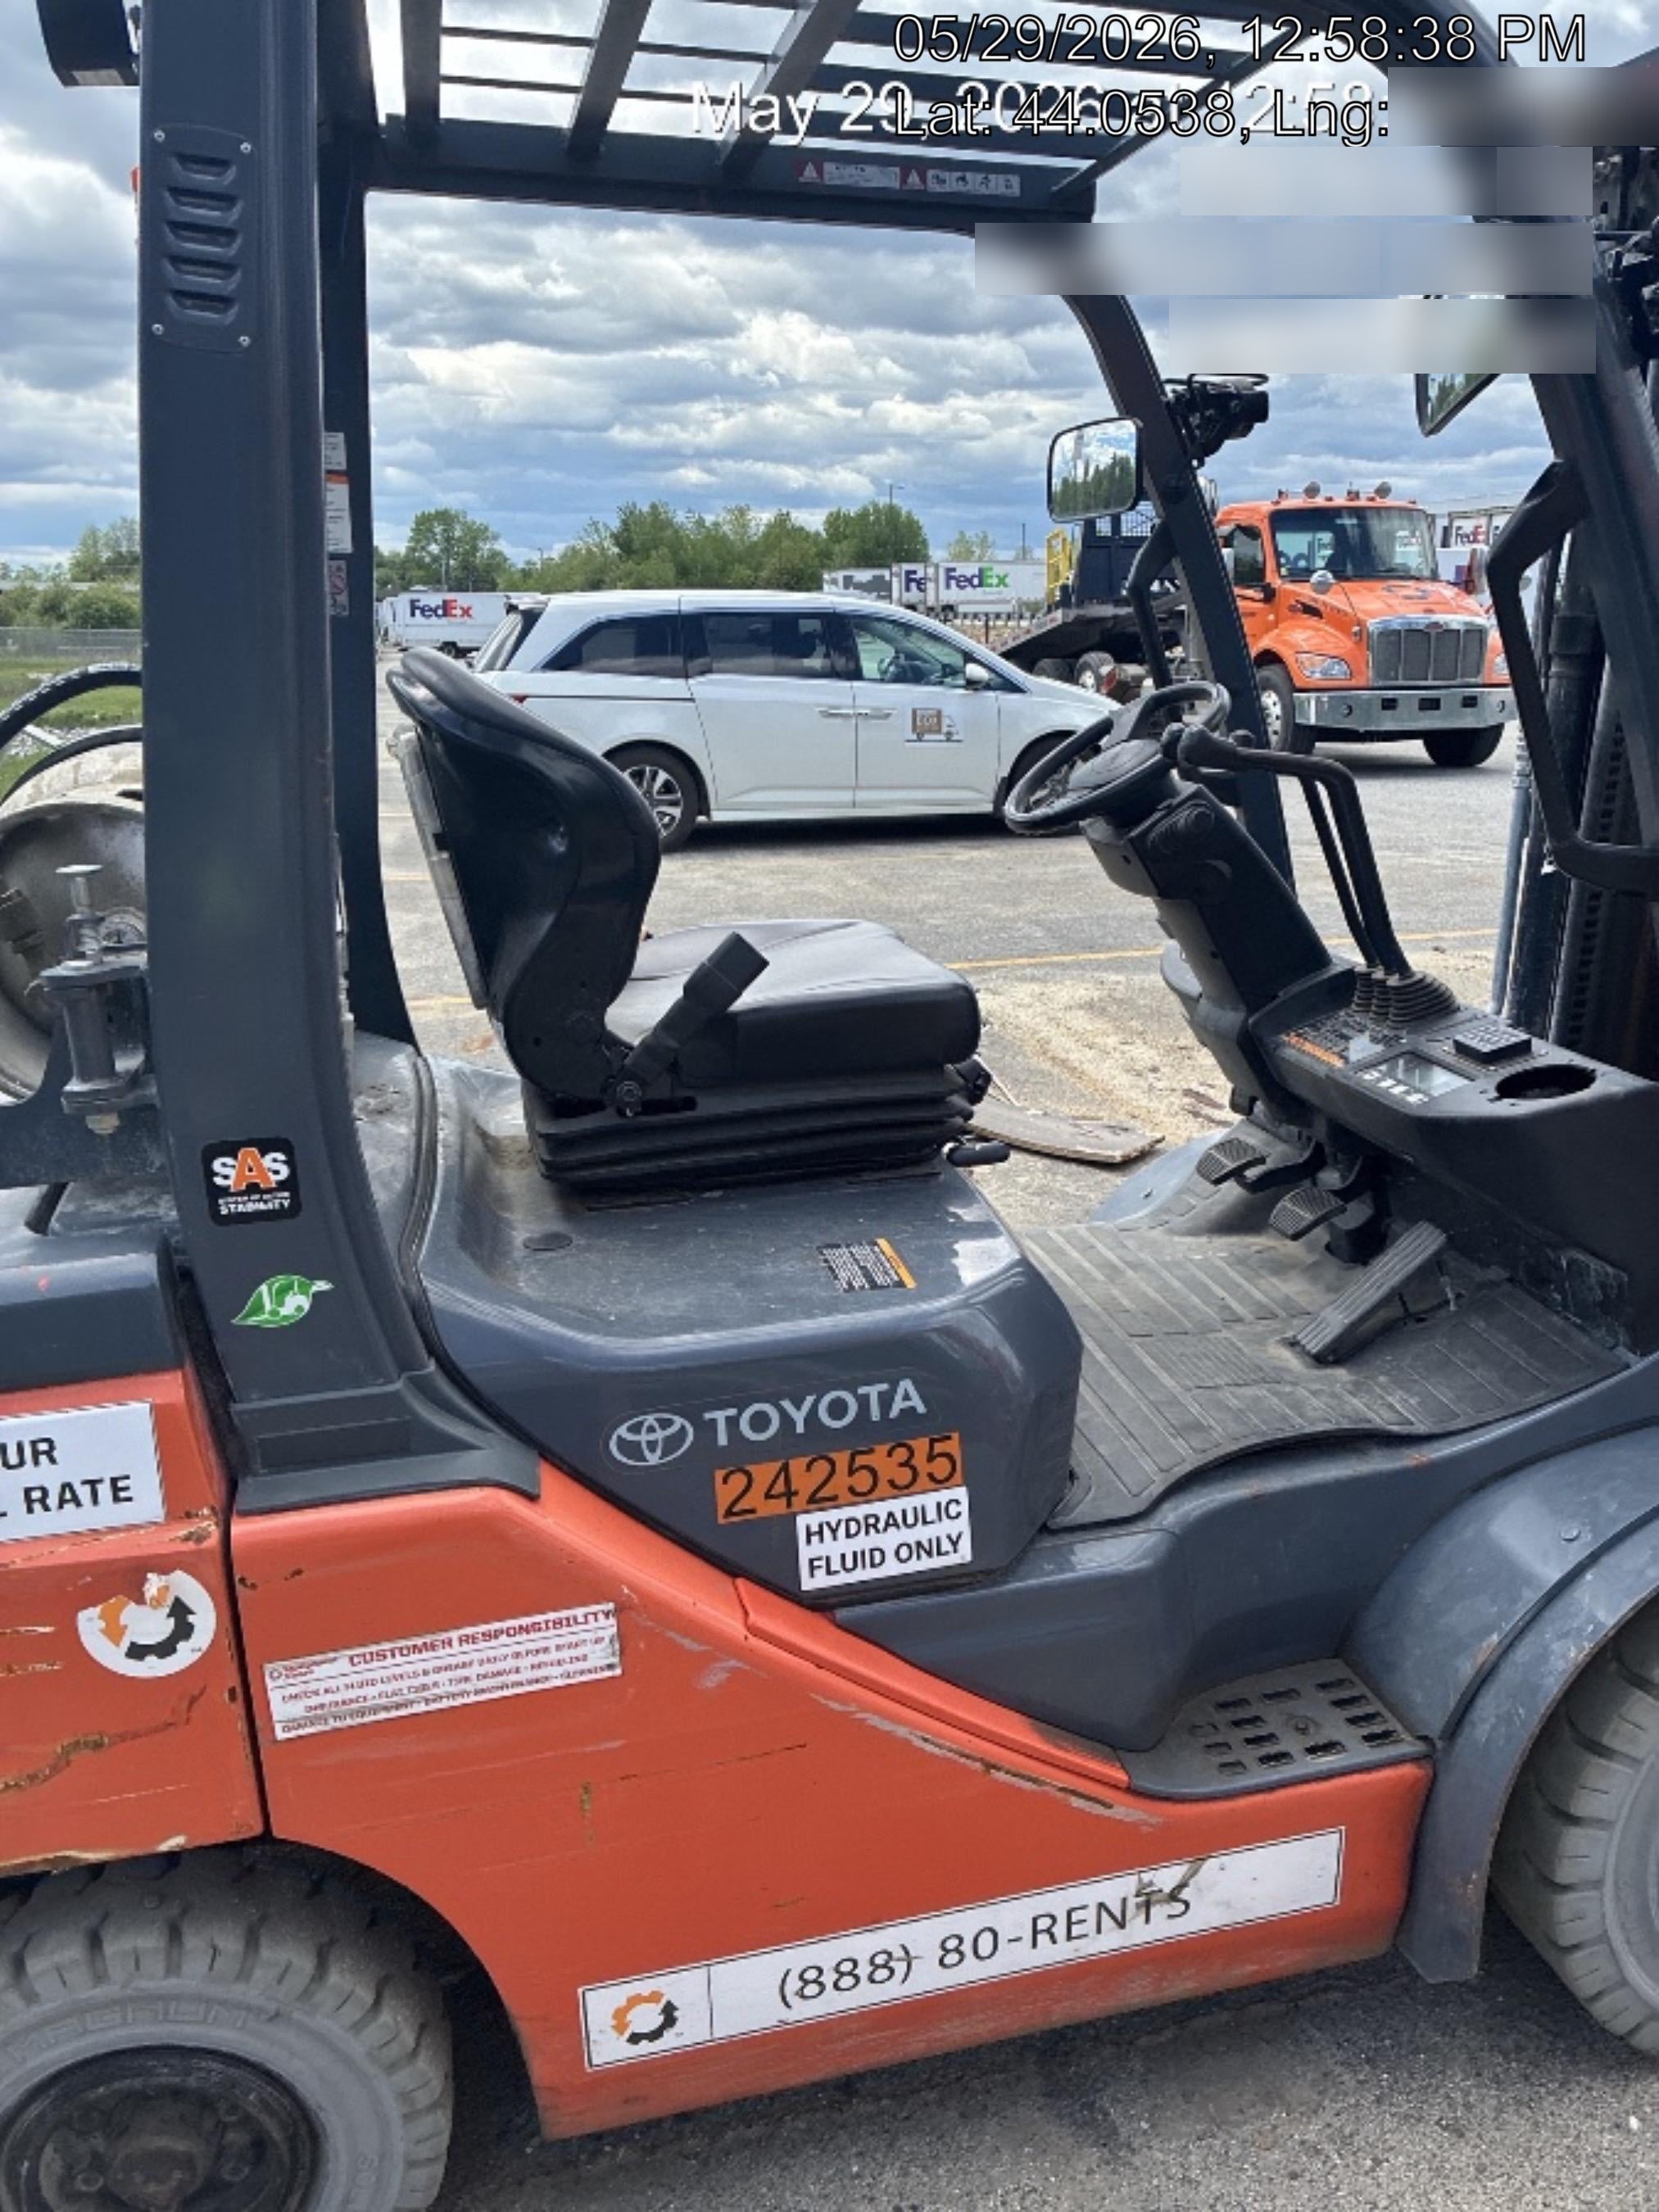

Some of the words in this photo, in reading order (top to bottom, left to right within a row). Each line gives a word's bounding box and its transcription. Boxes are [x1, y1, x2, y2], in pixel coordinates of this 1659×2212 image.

[944, 565, 1009, 591] FedEx
[410, 598, 473, 619] FedEx
[211, 1147, 291, 1192] SAS
[703, 1378, 928, 1447] TOYOTA
[23, 1474, 134, 1516] RATE
[722, 1435, 959, 1520] 242535
[804, 1498, 963, 1546] HYDRAULIC
[808, 1548, 886, 1579] FLUID
[895, 1532, 964, 1565] ONLY
[348, 1637, 452, 1666] CUSTOMER
[458, 1607, 613, 1646] RESPONSIBILITY
[777, 1944, 913, 2008] (888)
[937, 1888, 1193, 1969] 80-RENTS
